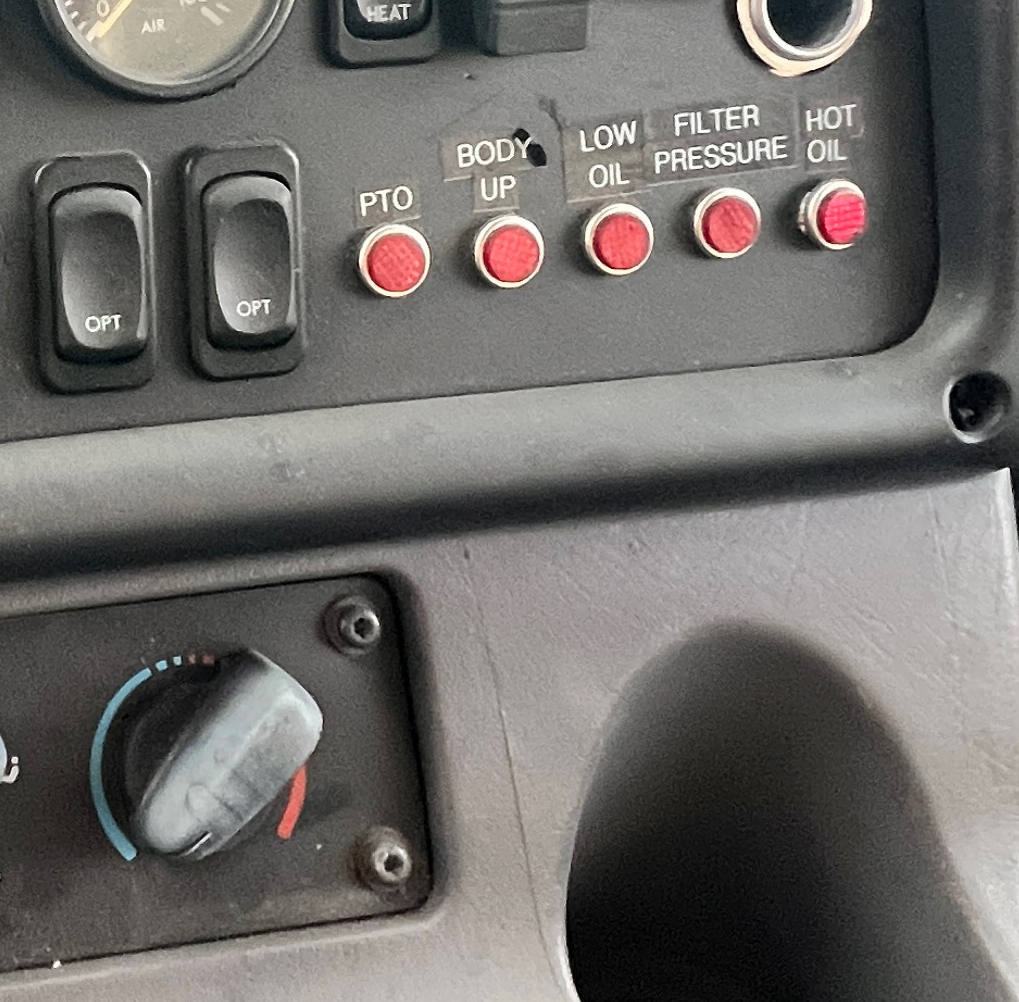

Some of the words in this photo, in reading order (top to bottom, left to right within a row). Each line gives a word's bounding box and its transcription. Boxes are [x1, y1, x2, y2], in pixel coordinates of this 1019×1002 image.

[140, 18, 166, 34] AIR
[366, 3, 412, 23] HEAT
[674, 104, 761, 137] FILTER
[805, 104, 857, 132] HOT
[580, 120, 637, 153] LOW
[456, 137, 532, 169] BODY
[654, 135, 789, 174] PRESSURE
[806, 138, 848, 164] OIL
[480, 175, 517, 202] UP
[588, 162, 630, 188] OIL
[359, 185, 414, 217] PTO
[236, 299, 271, 318] OPT
[84, 314, 122, 333] OPT
